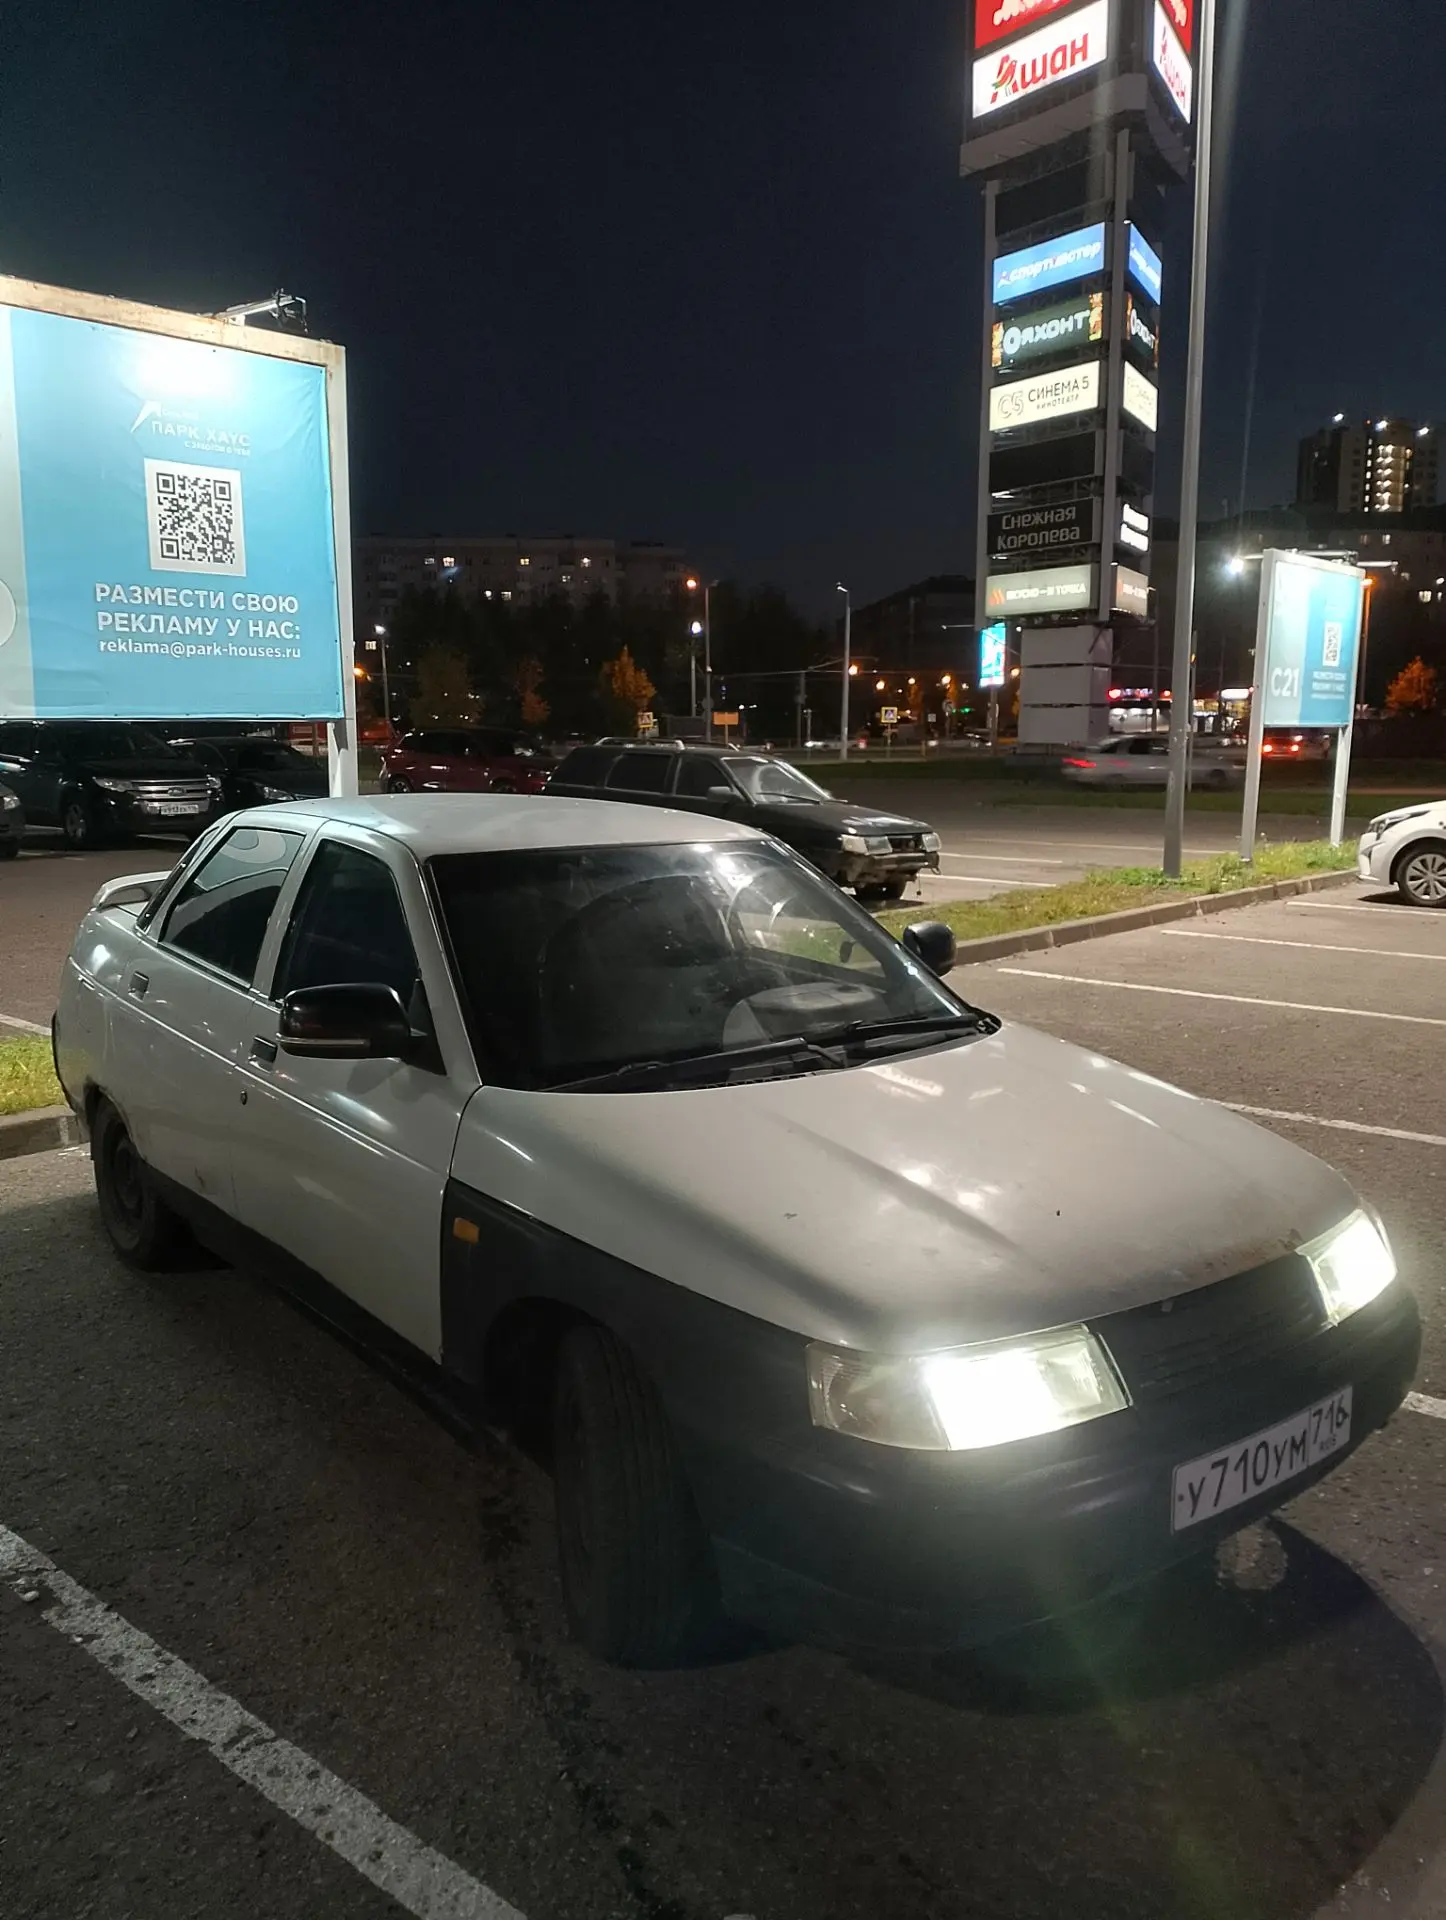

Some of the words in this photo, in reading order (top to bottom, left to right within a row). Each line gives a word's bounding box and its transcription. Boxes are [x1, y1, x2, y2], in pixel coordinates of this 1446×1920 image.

[1028, 378, 1079, 402] СИНЕМА
[1082, 376, 1090, 389] 5
[151, 420, 200, 440] ПАРК
[205, 428, 251, 447] ХАУС
[1002, 506, 1077, 530] Снежная
[997, 526, 1081, 550] Королева
[95, 583, 225, 610] РАЗМЕСТИ
[232, 592, 299, 614] СВОЮ
[97, 611, 219, 636] РЕКЛАМУ
[226, 618, 241, 637] У
[248, 619, 301, 640] НАС:
[99, 638, 301, 659] reklama@park-houses.ru
